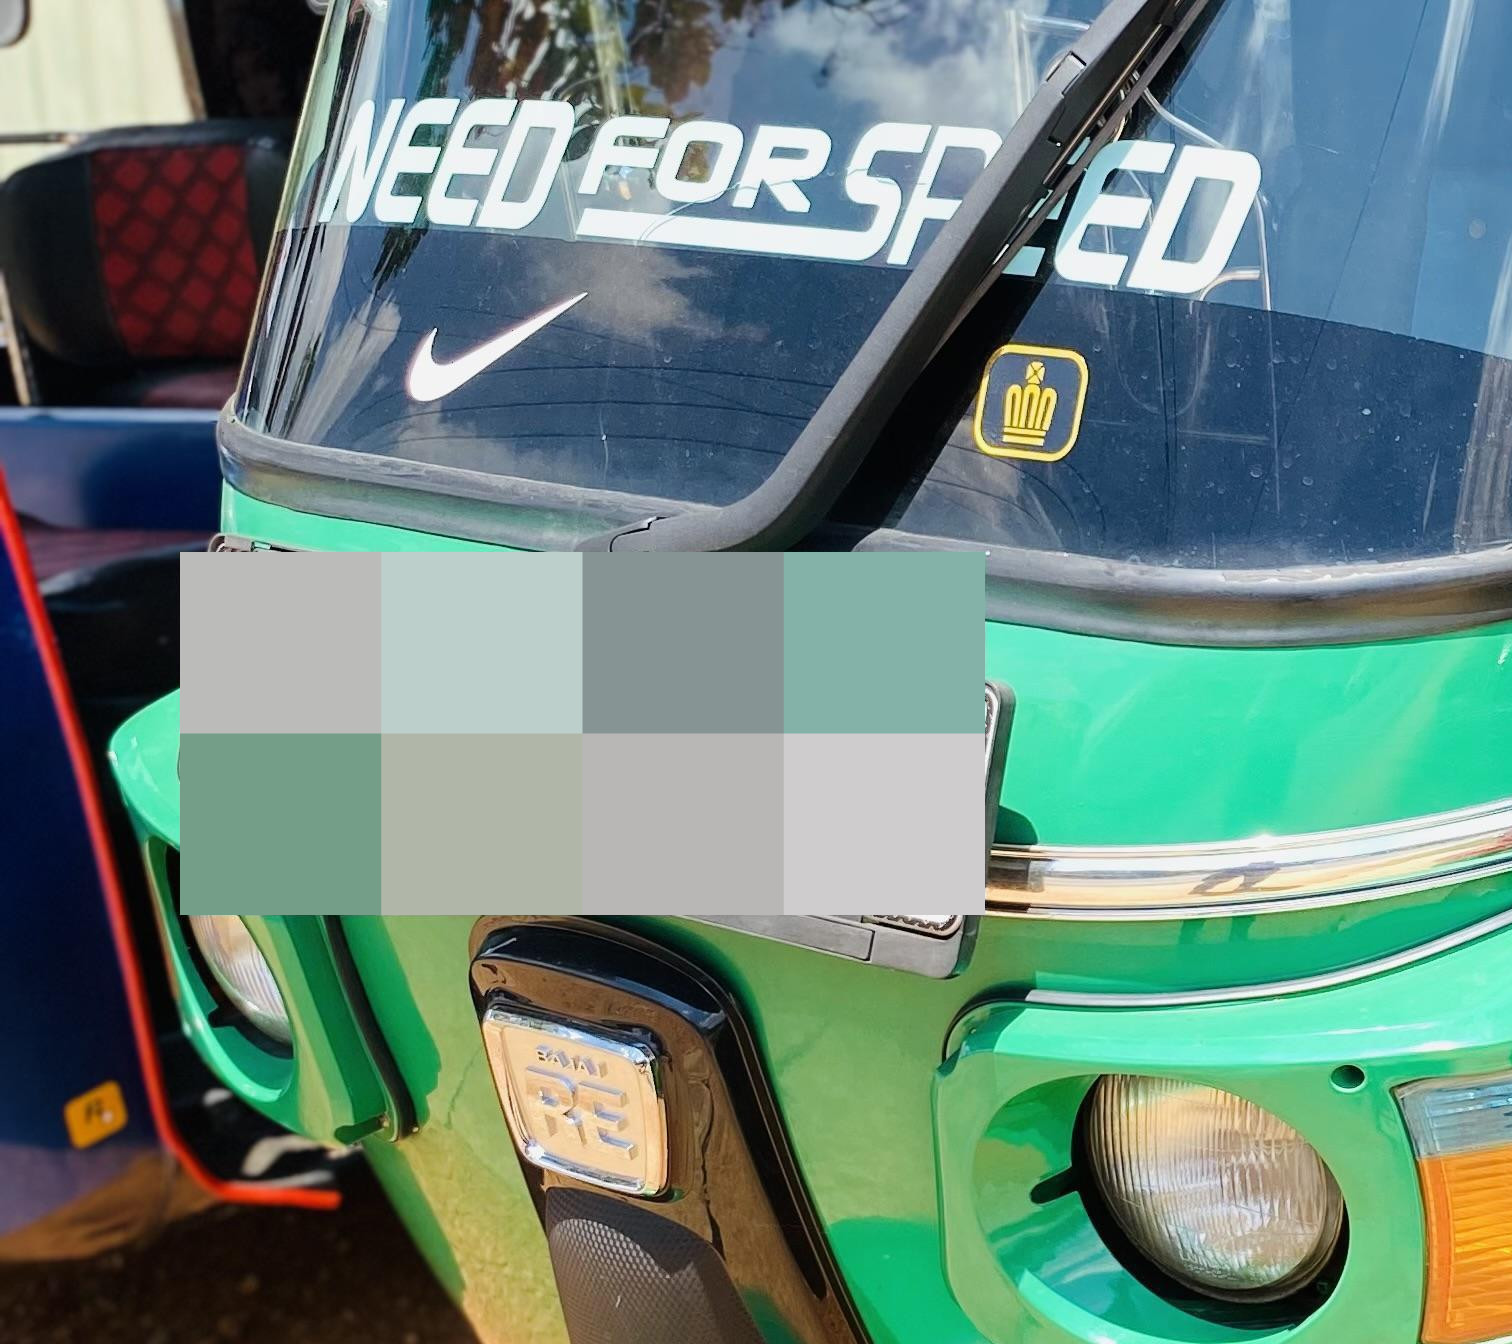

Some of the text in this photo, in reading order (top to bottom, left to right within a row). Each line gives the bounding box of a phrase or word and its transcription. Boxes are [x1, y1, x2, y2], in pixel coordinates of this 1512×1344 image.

[318, 98, 576, 230] NEED
[577, 115, 832, 213] FOR
[525, 1065, 635, 1161] RE
